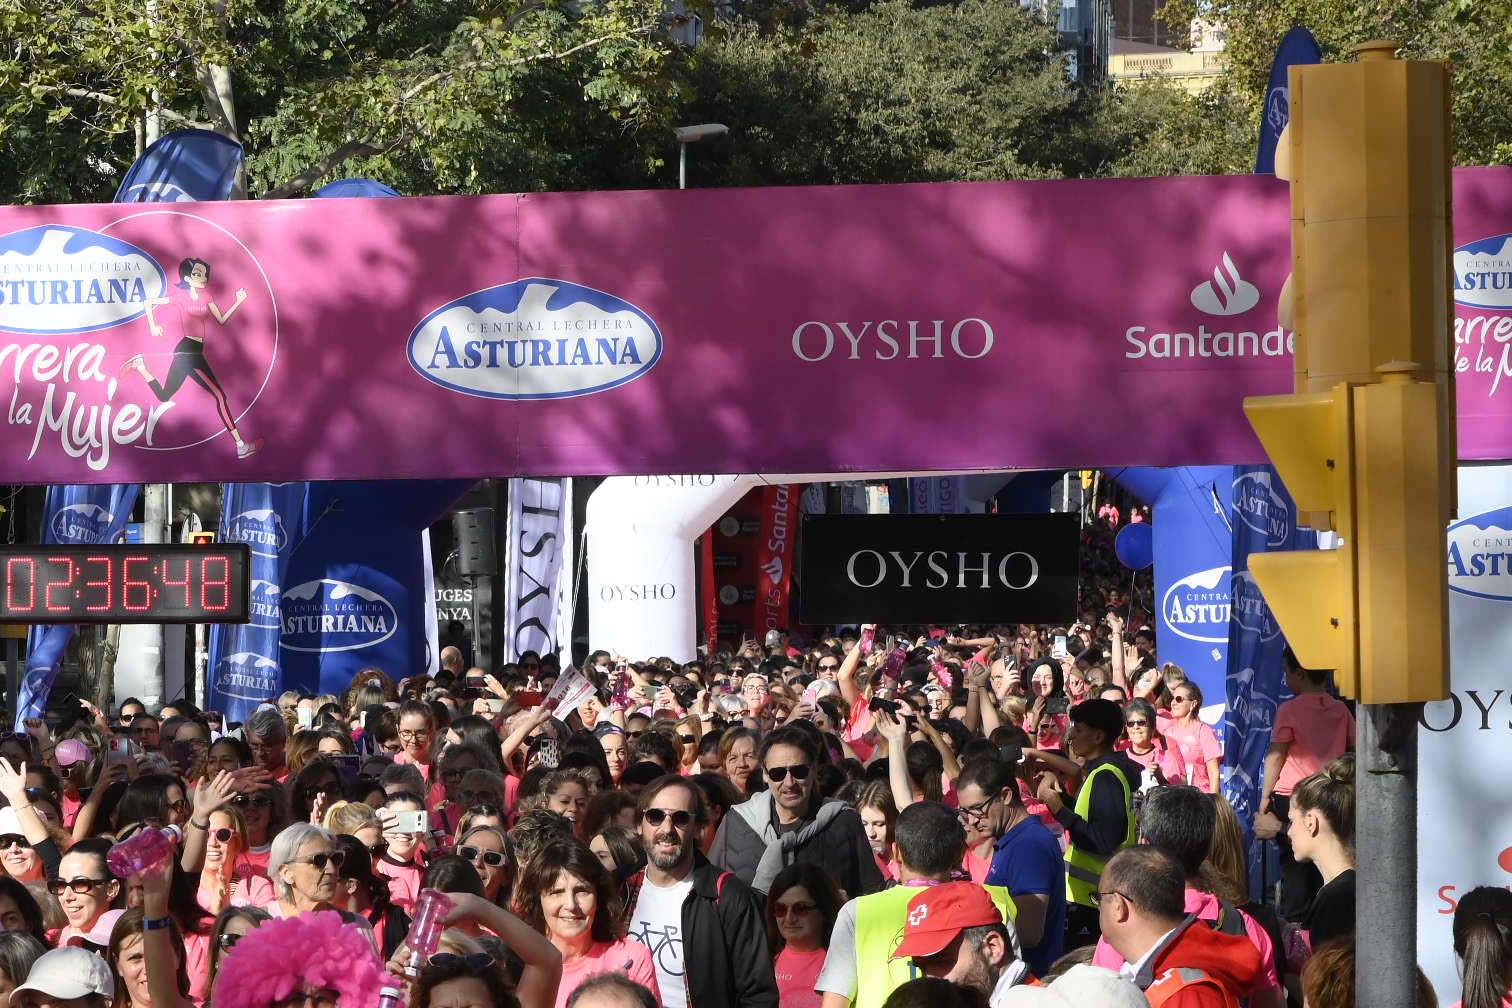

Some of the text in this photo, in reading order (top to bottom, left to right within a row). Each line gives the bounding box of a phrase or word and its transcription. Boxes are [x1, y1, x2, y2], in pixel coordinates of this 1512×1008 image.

[1466, 260, 1512, 269] CENTRA
[1454, 271, 1512, 291] STU
[467, 319, 634, 333] CENTRAL LECHERA
[791, 317, 995, 362] OYSHO
[427, 325, 642, 369] ASTURIANA
[1125, 325, 1295, 359] Santande
[1475, 343, 1494, 373] la
[7, 383, 33, 425] la
[27, 377, 176, 471] Mujer
[1473, 538, 1512, 548] CENT
[6, 556, 230, 611] 02:36:48
[846, 549, 1040, 590] OYSHO
[600, 582, 676, 602] OYSHO
[1187, 592, 1229, 601] CENTRA
